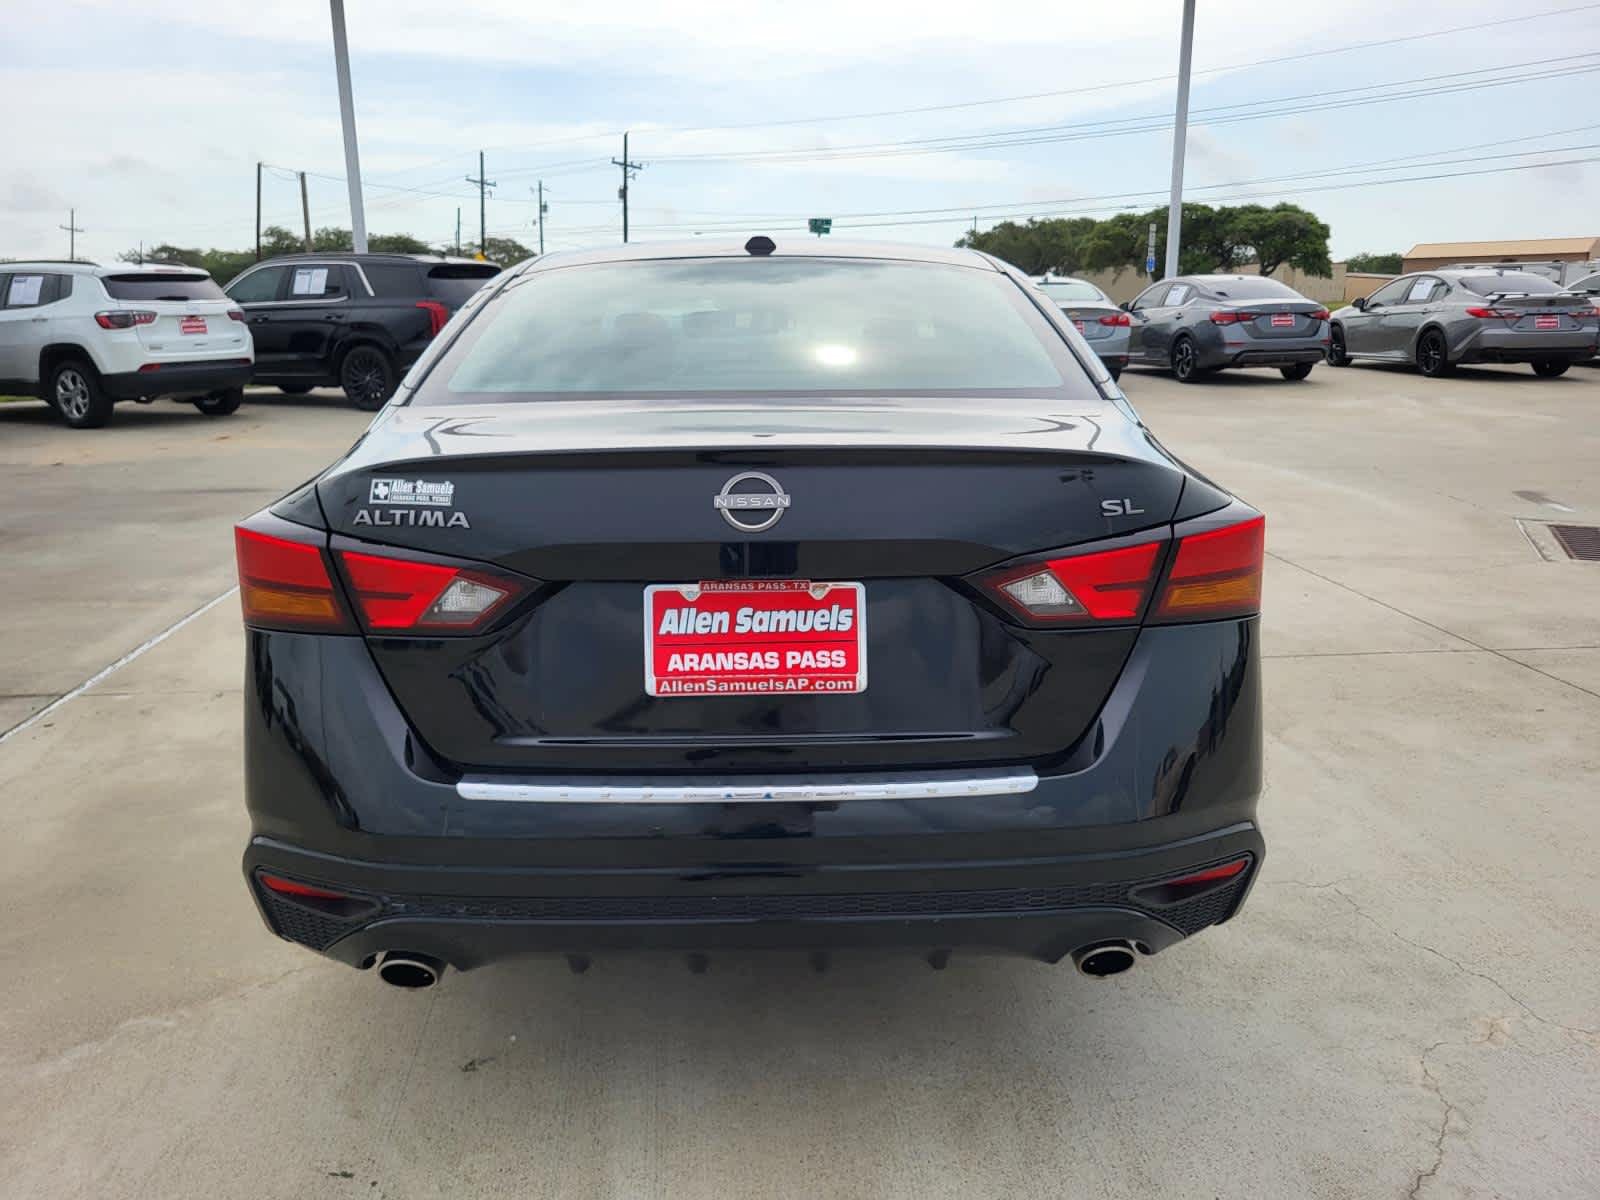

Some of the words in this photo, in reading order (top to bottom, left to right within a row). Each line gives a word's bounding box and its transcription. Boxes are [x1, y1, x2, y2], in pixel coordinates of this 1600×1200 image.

[716, 497, 789, 507] NISSAN
[1101, 498, 1145, 516] SL
[353, 509, 470, 528] ALTIMA
[703, 582, 754, 590] ARANSAS
[793, 582, 809, 590] TX
[659, 607, 730, 635] Allen
[735, 604, 853, 634] Samuels
[667, 651, 780, 672] ARANSAS
[786, 649, 847, 669] PASS
[659, 678, 854, 693] AllenSamuelsAP.com
